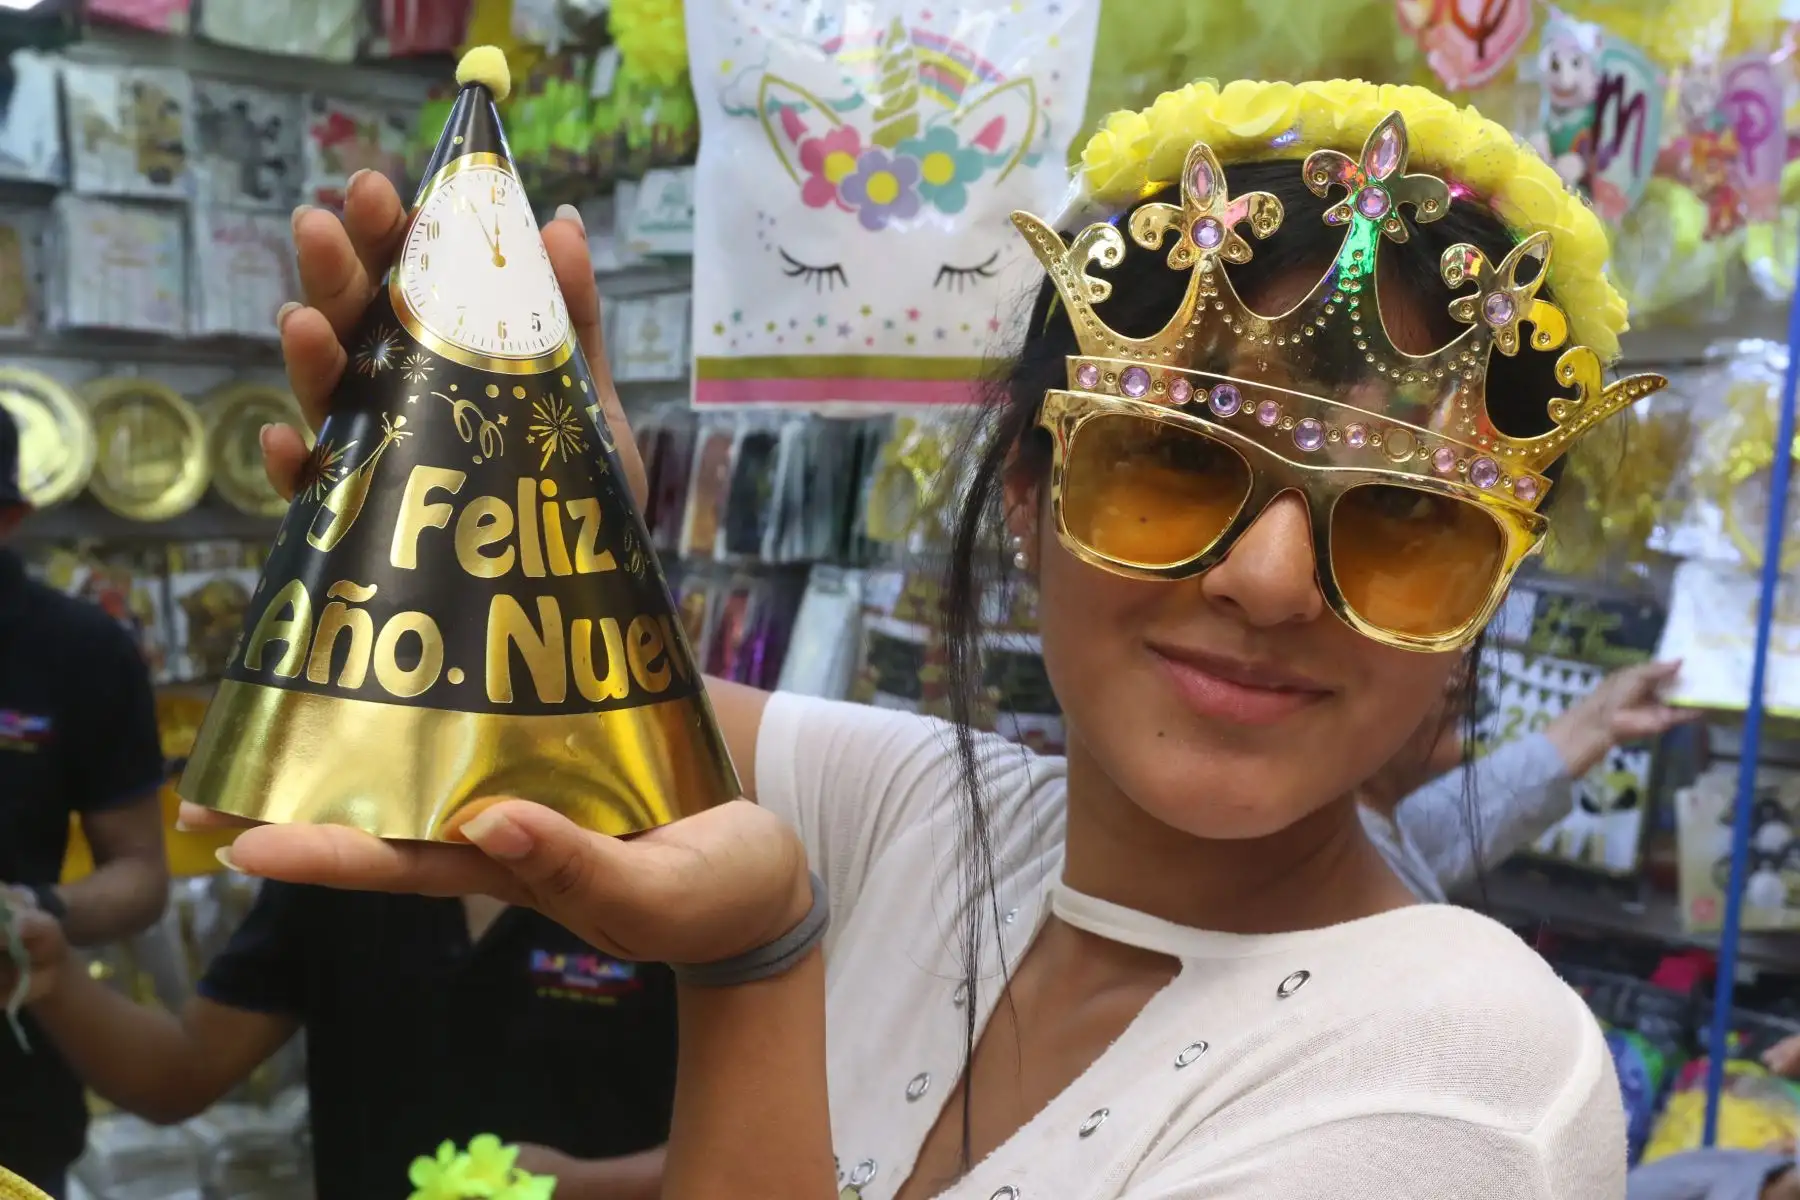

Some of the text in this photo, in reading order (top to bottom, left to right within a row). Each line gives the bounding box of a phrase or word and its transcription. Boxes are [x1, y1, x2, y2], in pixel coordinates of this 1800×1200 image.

[491, 185, 506, 207] 12
[426, 220, 440, 241] 10
[420, 252, 430, 273] 9
[453, 305, 467, 338] 7
[497, 320, 508, 340] 6
[531, 312, 542, 332] 5
[390, 465, 617, 579] Feliz
[244, 579, 465, 698] Año.
